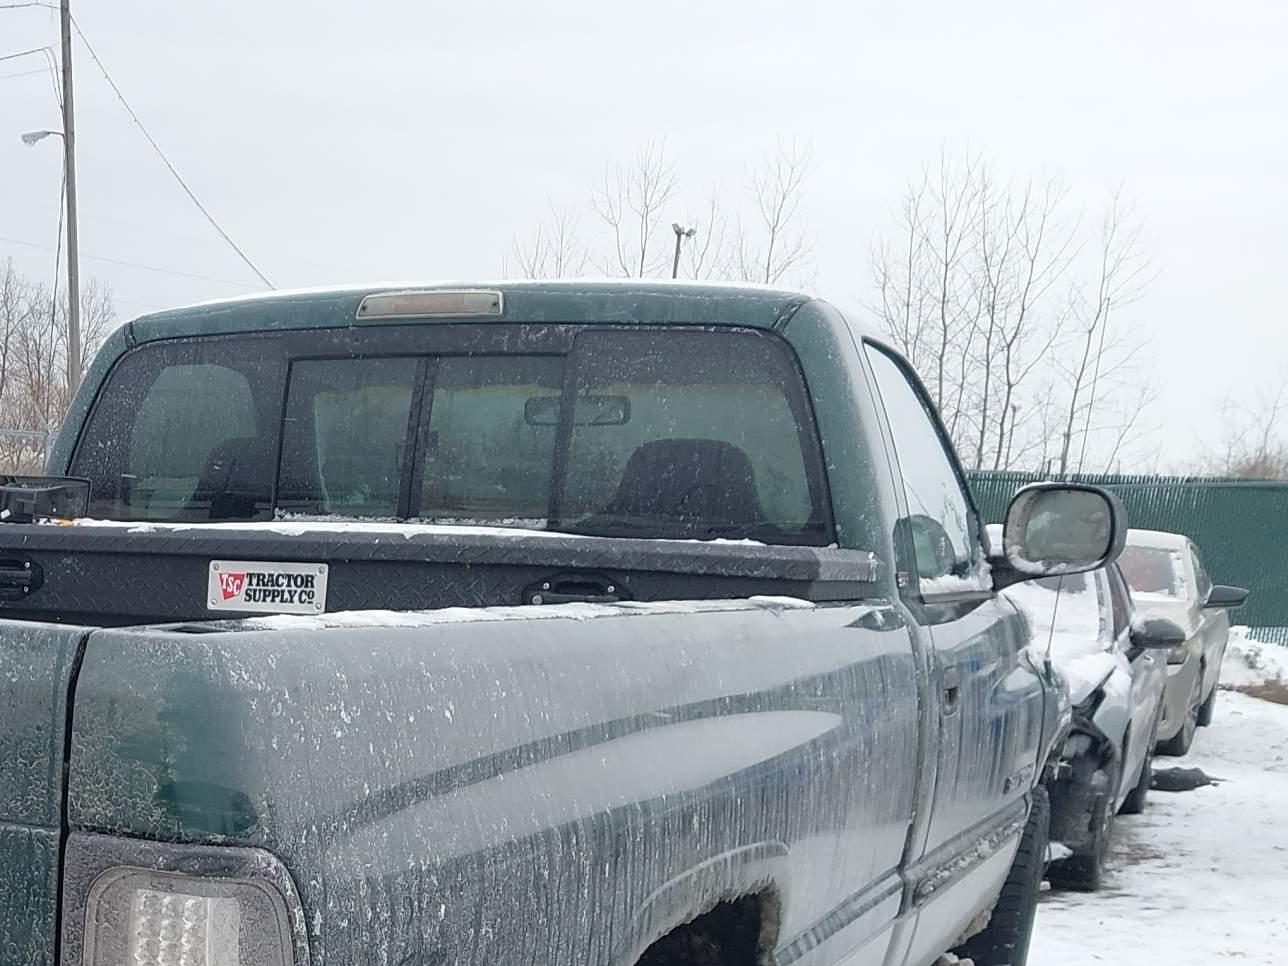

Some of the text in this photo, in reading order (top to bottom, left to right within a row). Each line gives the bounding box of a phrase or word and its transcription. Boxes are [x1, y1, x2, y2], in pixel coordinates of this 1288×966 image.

[220, 573, 242, 597] TSC
[245, 572, 316, 589] TRACTOR
[243, 588, 299, 605] SUPPLY
